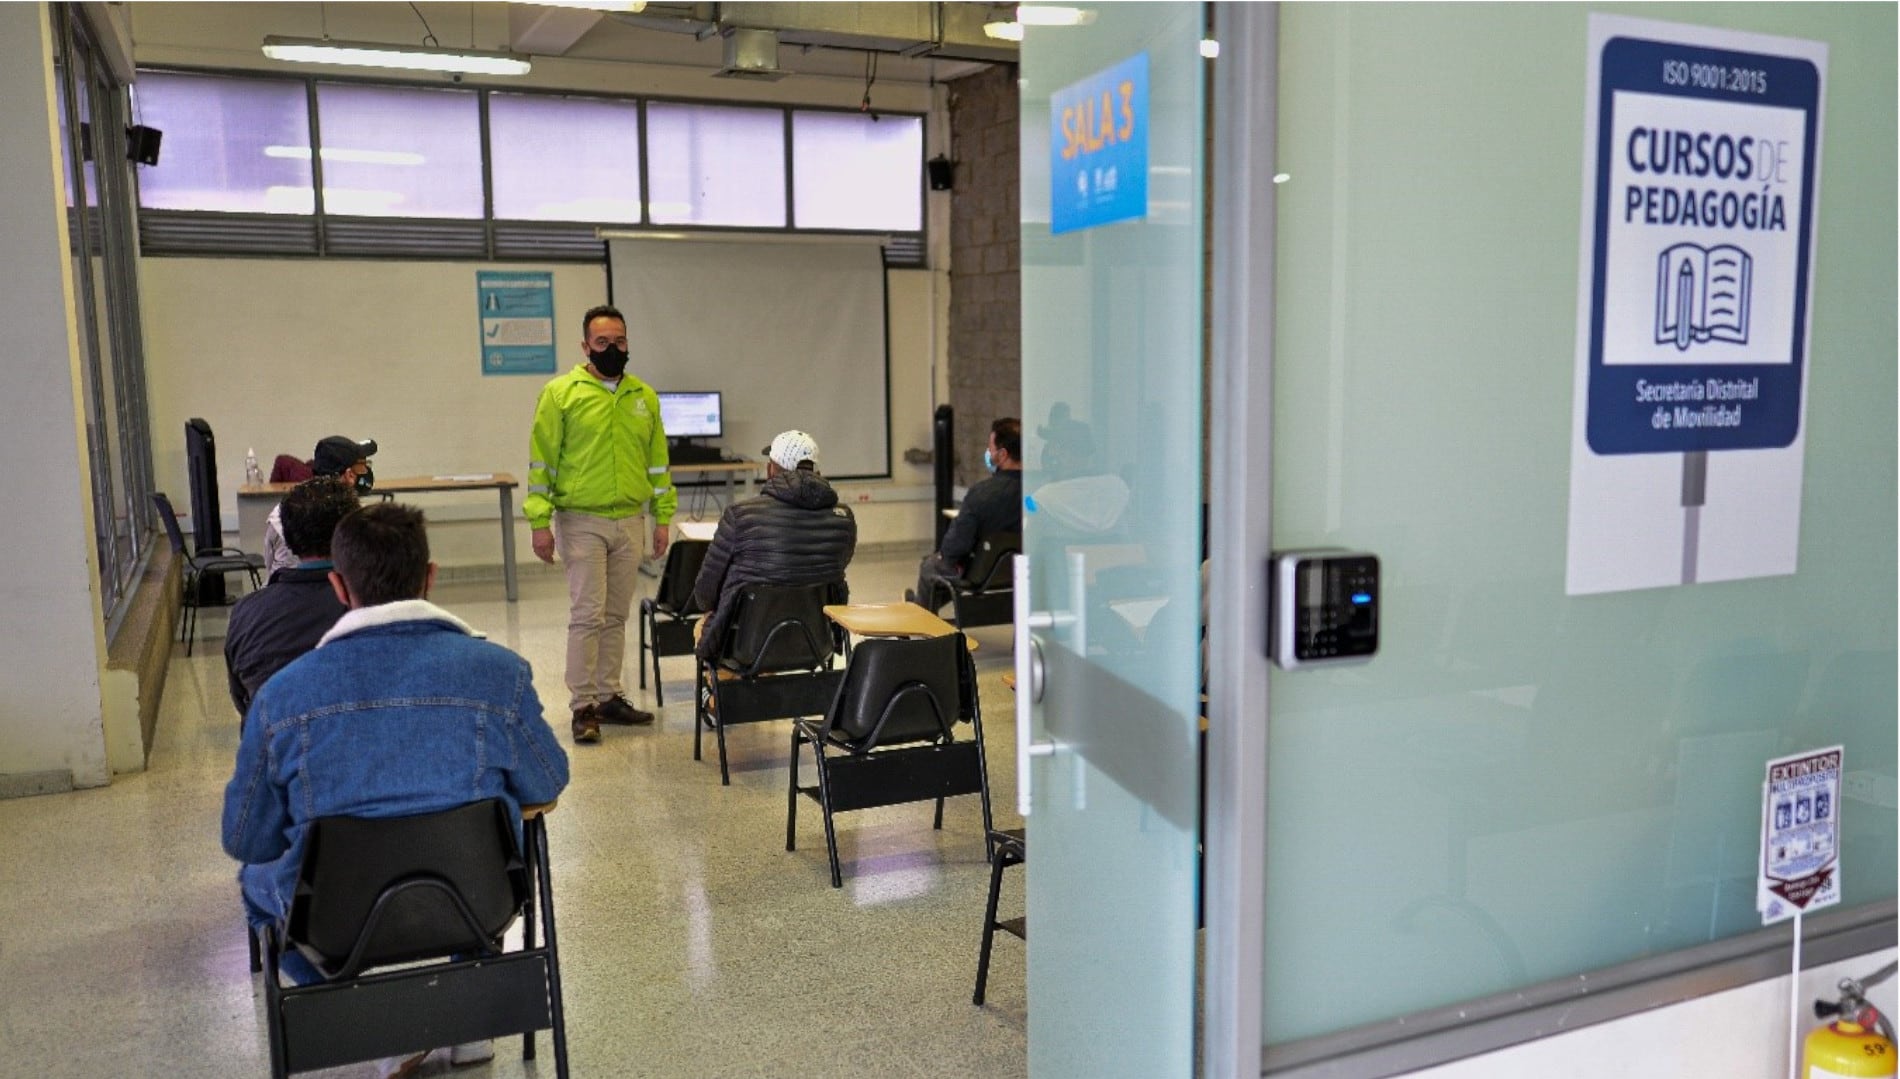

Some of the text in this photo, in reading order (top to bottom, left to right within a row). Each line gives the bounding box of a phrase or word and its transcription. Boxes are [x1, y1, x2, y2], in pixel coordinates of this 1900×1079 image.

[1663, 60, 1767, 94] ISO 9001:2015
[1061, 80, 1134, 159] SALA 3
[1626, 126, 1789, 184] CURSOS DE
[1625, 184, 1787, 231] PEDAGOGÍA
[1706, 377, 1759, 400] Distrital
[1652, 403, 1742, 428] de Movilidad
[1772, 754, 1839, 781] EXTINTOR
